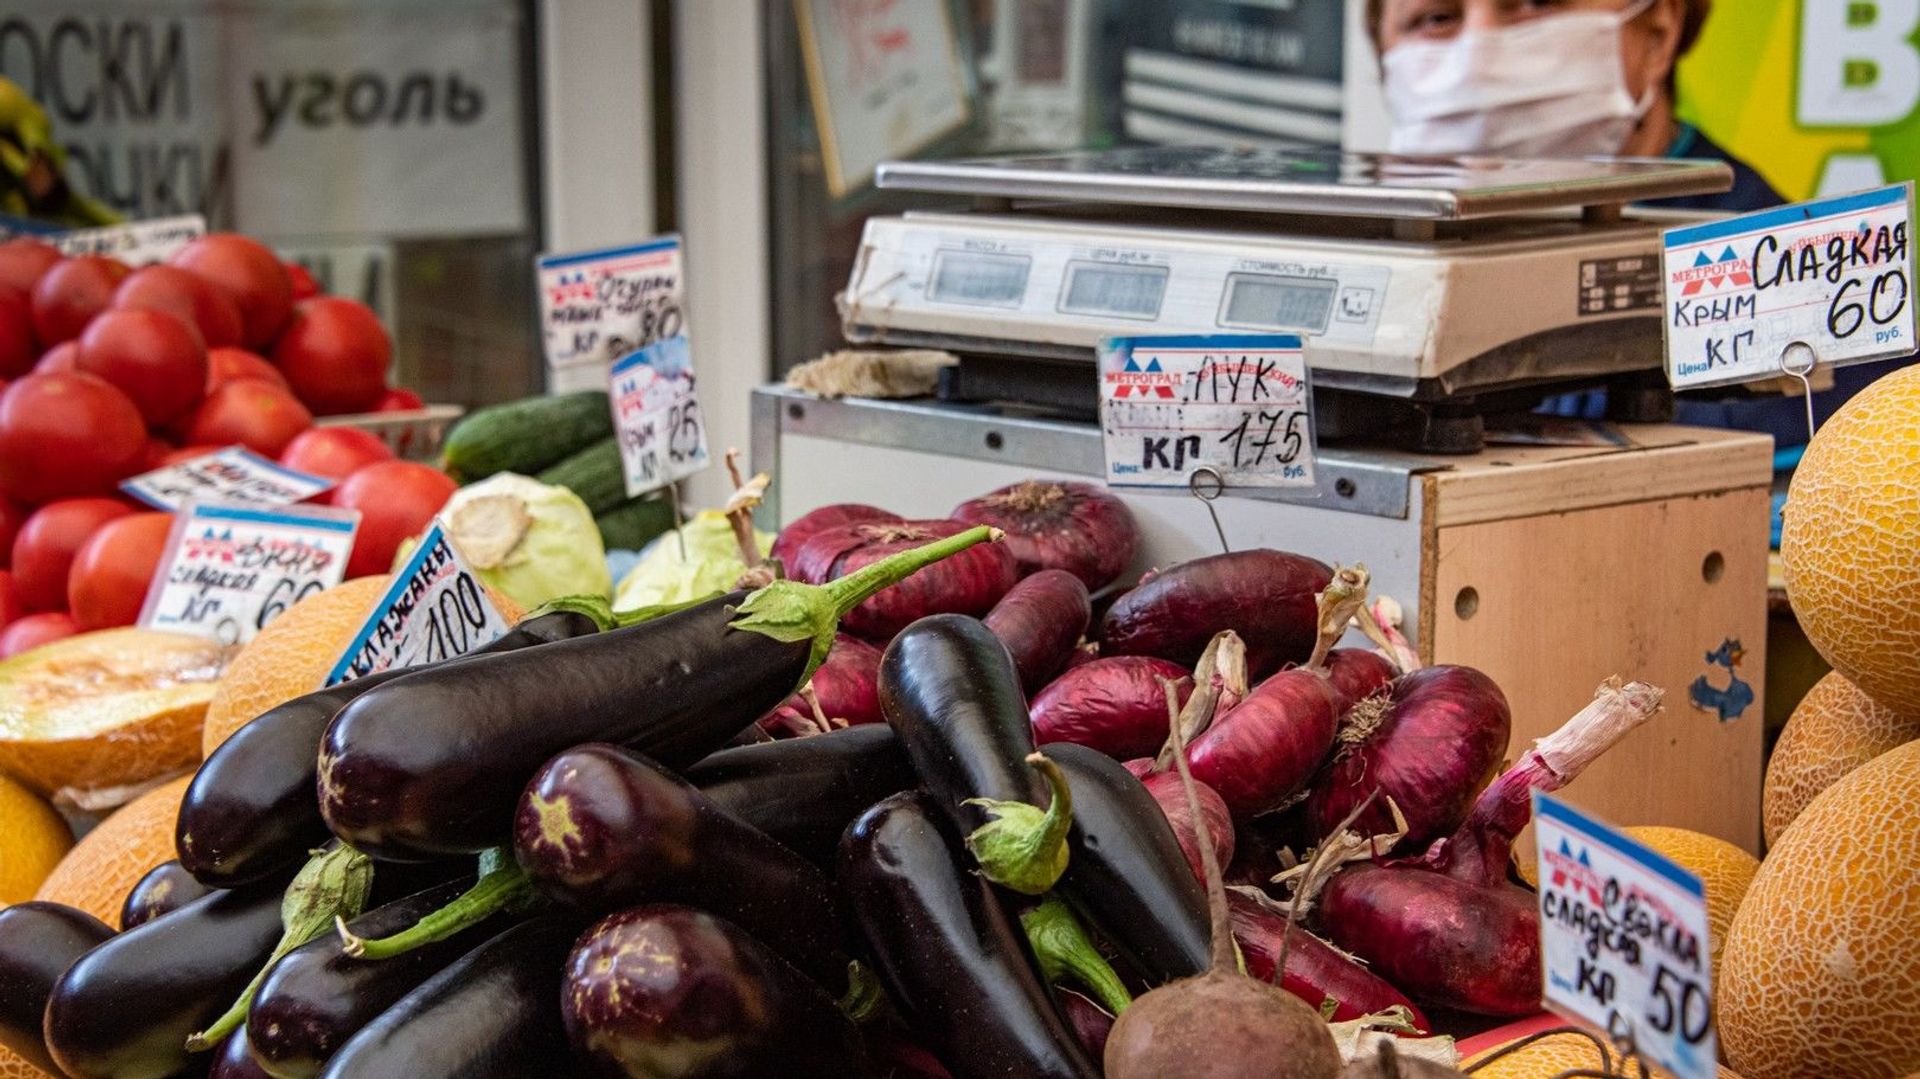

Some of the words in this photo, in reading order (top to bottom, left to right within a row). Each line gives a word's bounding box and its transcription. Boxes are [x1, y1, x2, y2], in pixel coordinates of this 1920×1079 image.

[253, 71, 485, 147] уголь
[1672, 260, 1758, 284] МЕТРОГРА
[1828, 270, 1907, 339] 60
[1876, 325, 1903, 344] руб.
[1105, 372, 1182, 385] МЕТРОГРАД
[1195, 355, 1276, 403] ЛУК
[1219, 410, 1309, 467] 175
[325, 537, 453, 688] КЛАЖАНЫ
[426, 571, 487, 663] 100
[1645, 965, 1711, 1044] 50
